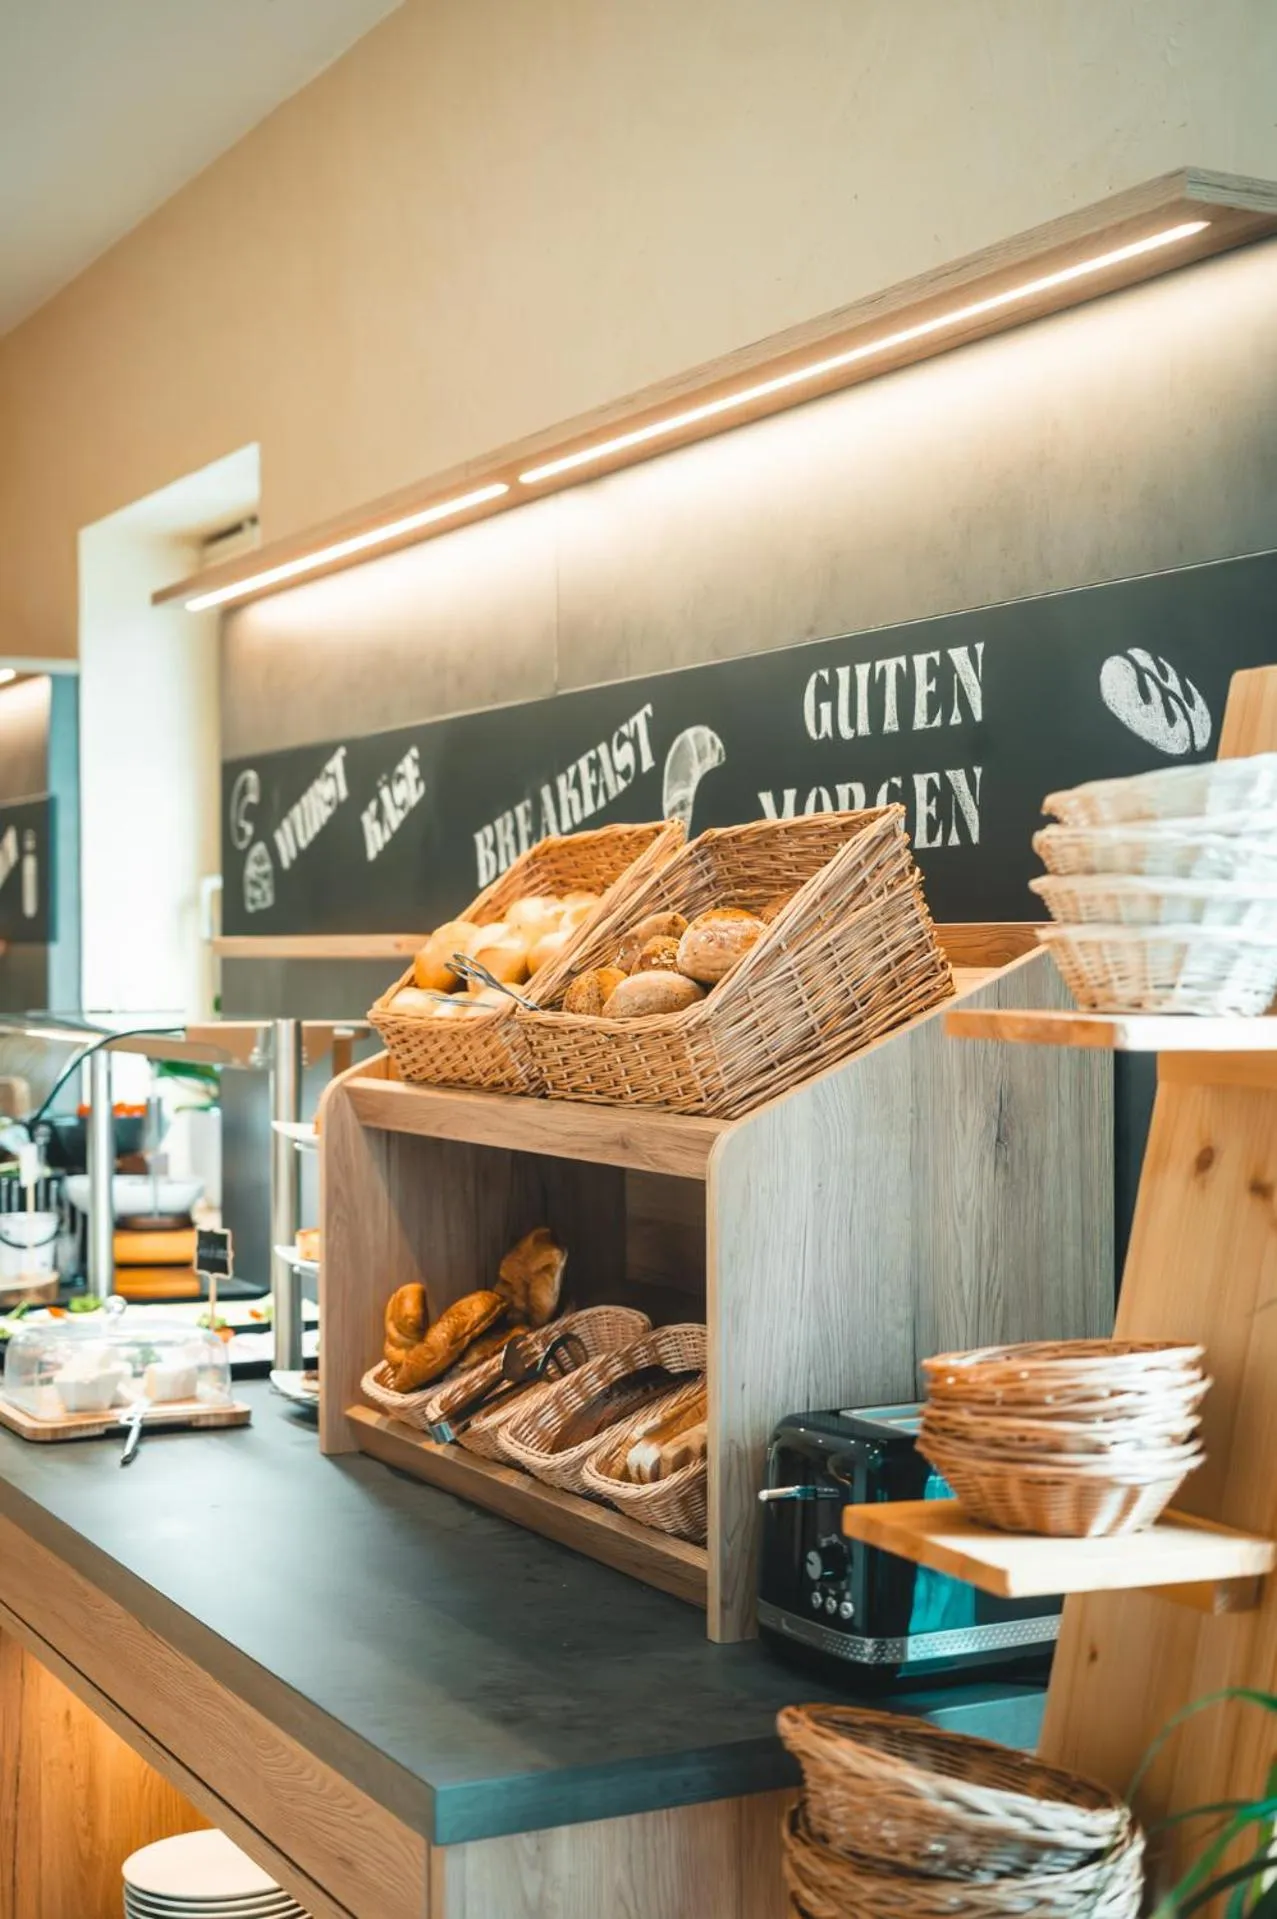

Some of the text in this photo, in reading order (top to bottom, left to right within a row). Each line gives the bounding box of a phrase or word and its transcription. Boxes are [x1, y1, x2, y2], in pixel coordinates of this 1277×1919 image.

[803, 642, 985, 741] GUTEN
[360, 745, 425, 862] KÄSE
[473, 702, 656, 889] BREAKFAST
